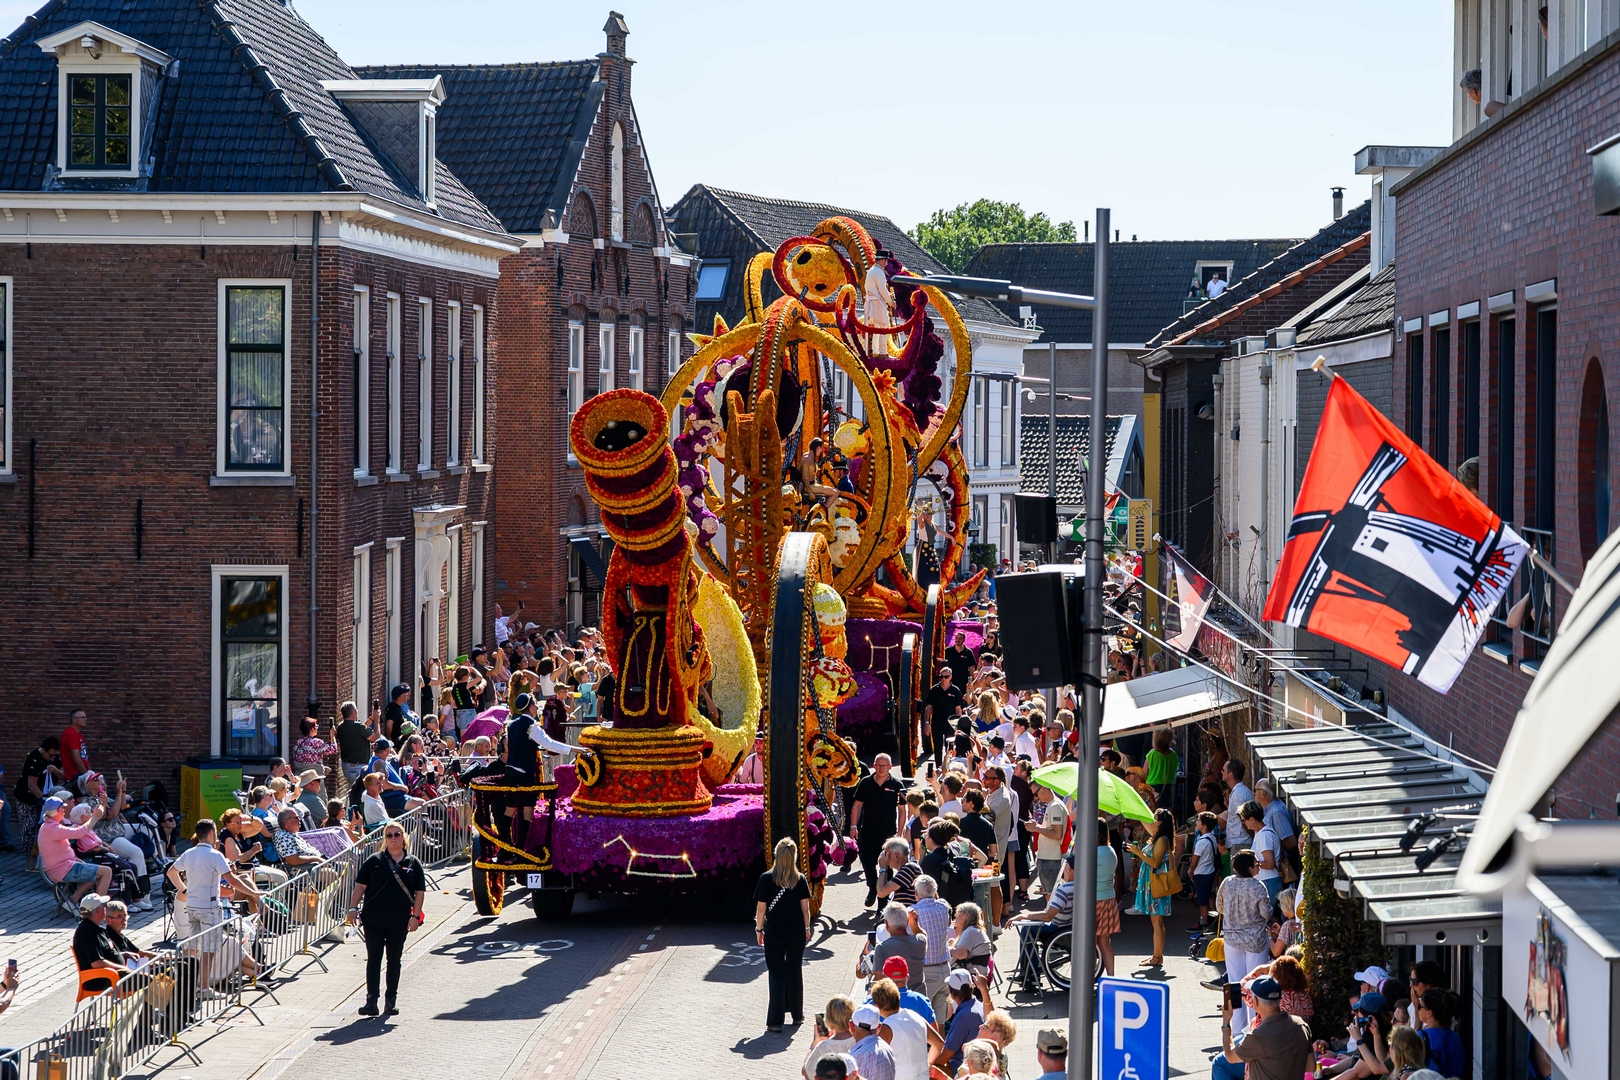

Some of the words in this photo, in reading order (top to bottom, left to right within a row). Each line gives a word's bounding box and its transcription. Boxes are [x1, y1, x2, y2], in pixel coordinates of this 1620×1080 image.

[1129, 500, 1151, 516] Capri
[529, 875, 540, 883] 17
[1115, 990, 1150, 1050] P
